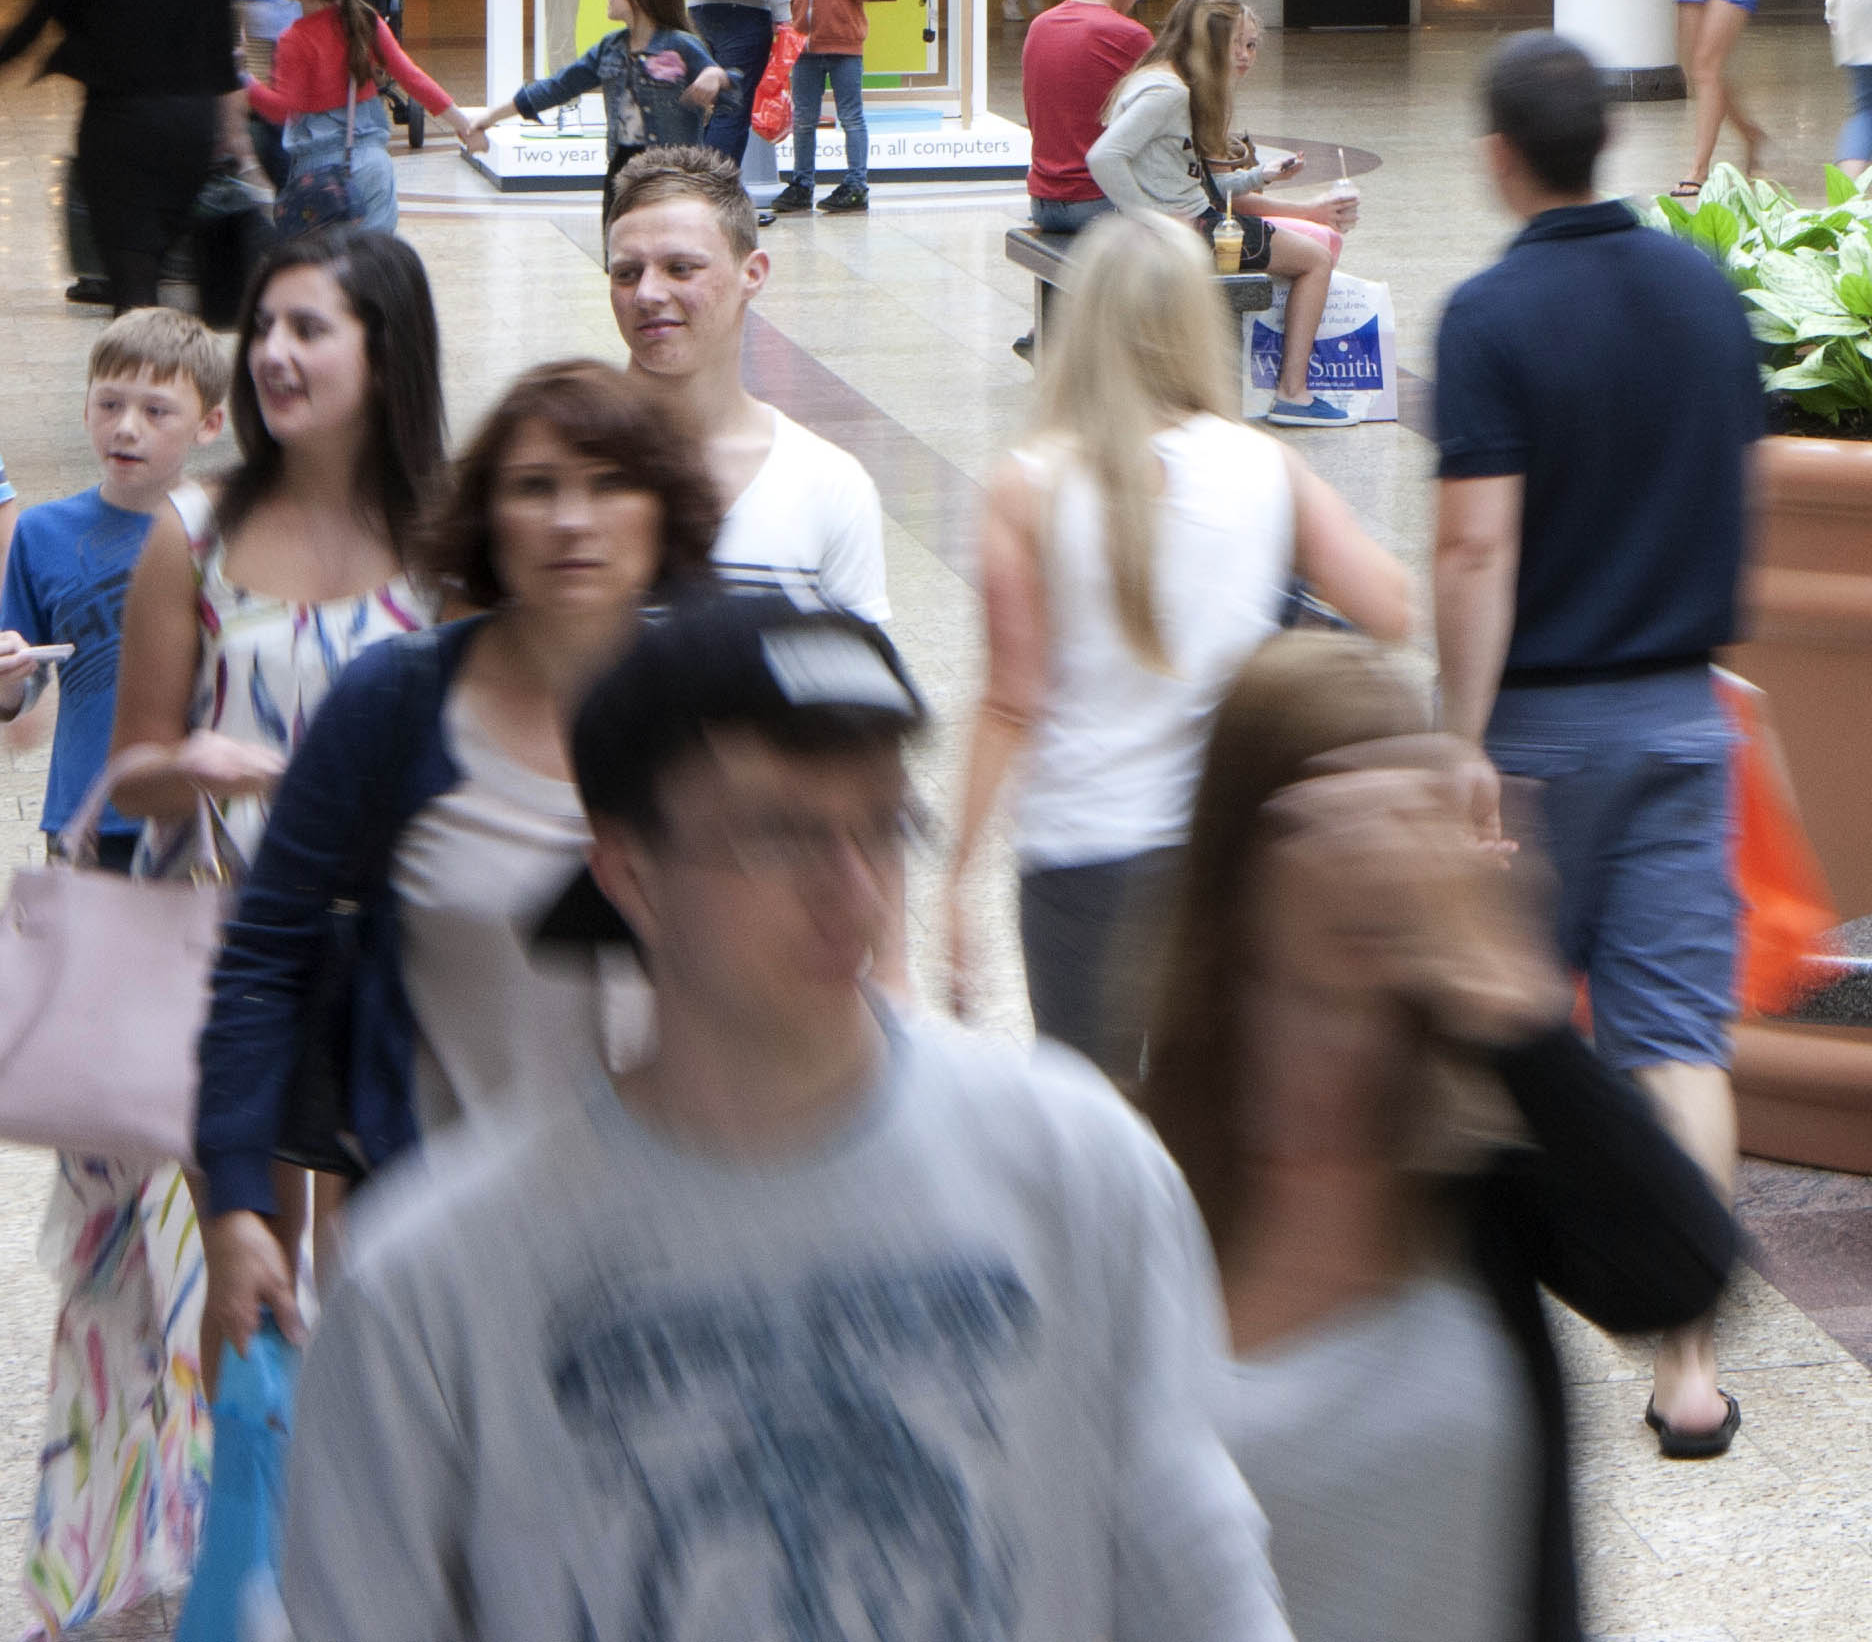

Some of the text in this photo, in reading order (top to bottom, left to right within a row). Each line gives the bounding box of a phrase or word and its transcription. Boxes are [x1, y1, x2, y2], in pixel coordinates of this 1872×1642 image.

[513, 145, 597, 166] Two year
[815, 145, 845, 157] cos
[887, 138, 907, 155] all
[913, 138, 1011, 158] computers
[1254, 350, 1380, 378] WSmith
